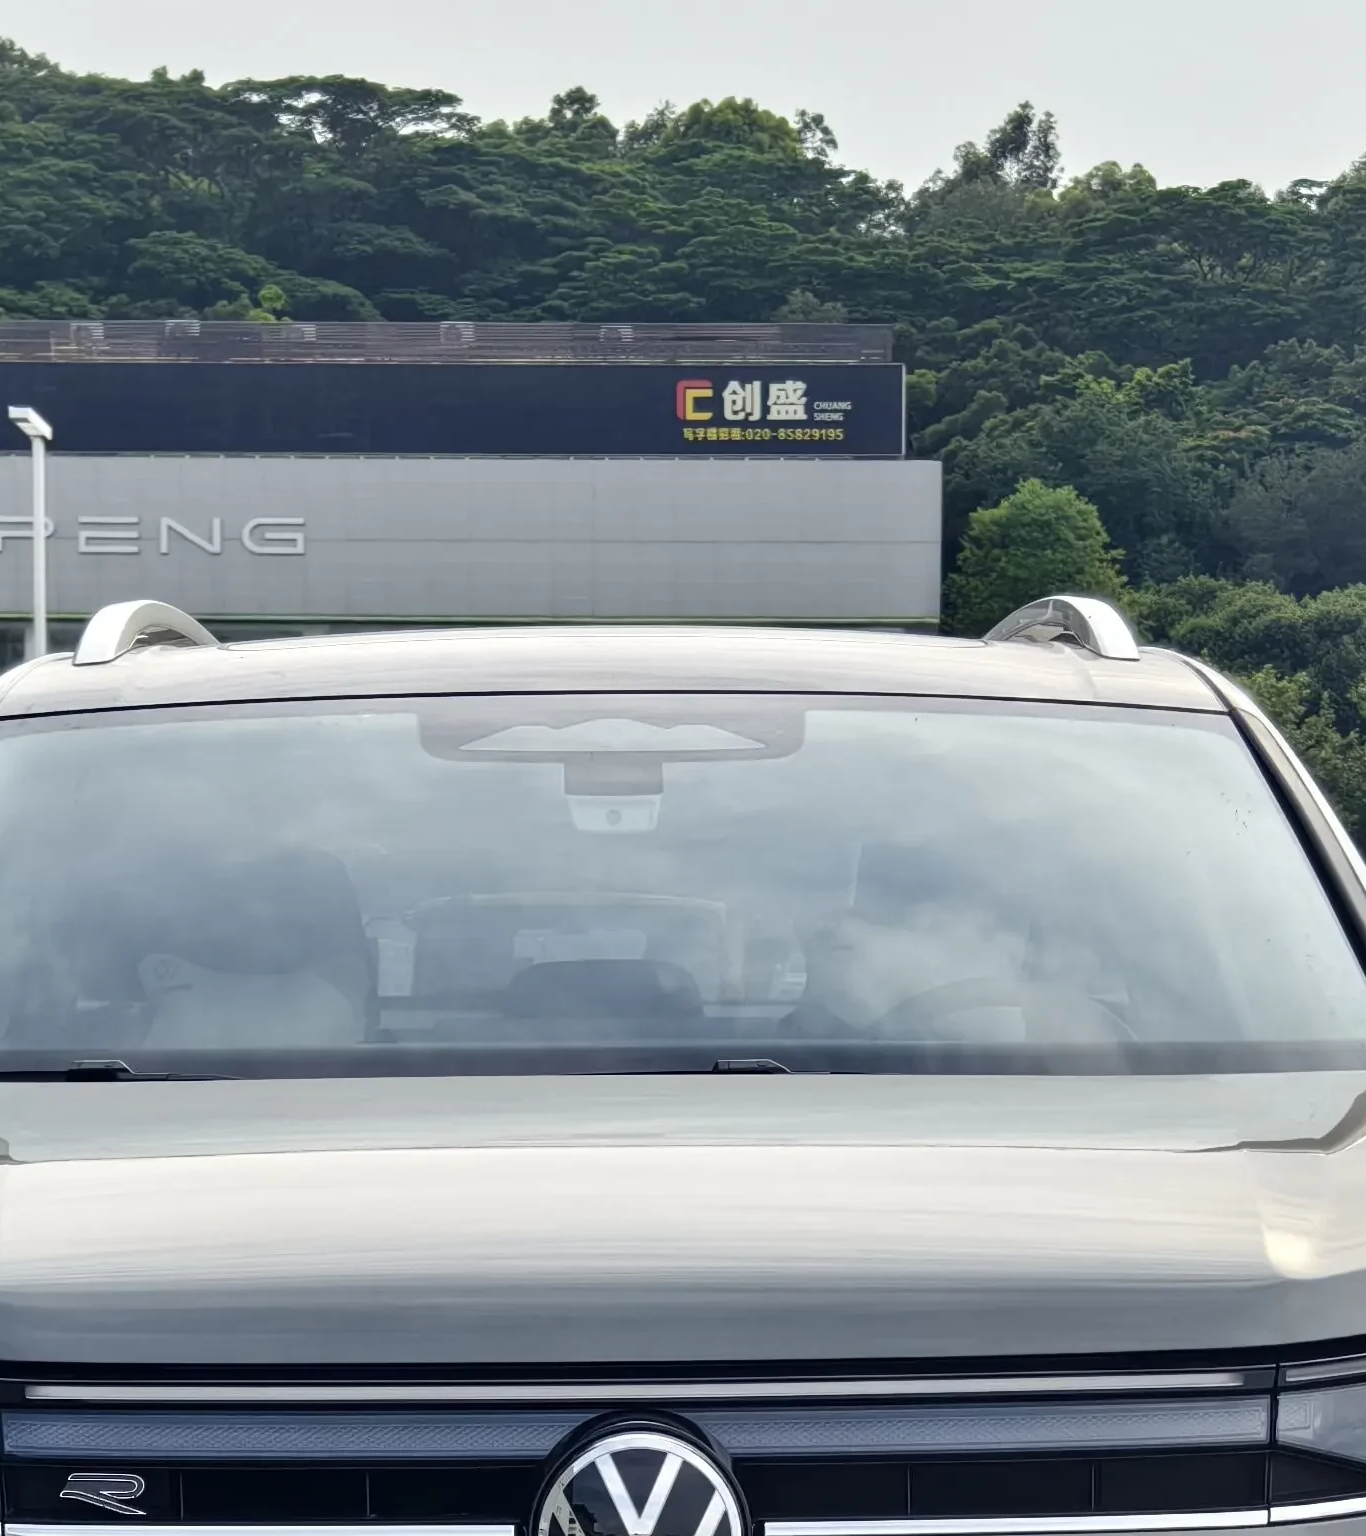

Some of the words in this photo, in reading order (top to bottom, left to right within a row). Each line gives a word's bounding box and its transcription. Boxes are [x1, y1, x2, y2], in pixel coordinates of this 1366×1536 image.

[722, 380, 808, 421] 创盛
[813, 401, 852, 411] CHUANG
[813, 412, 844, 422] SHENG
